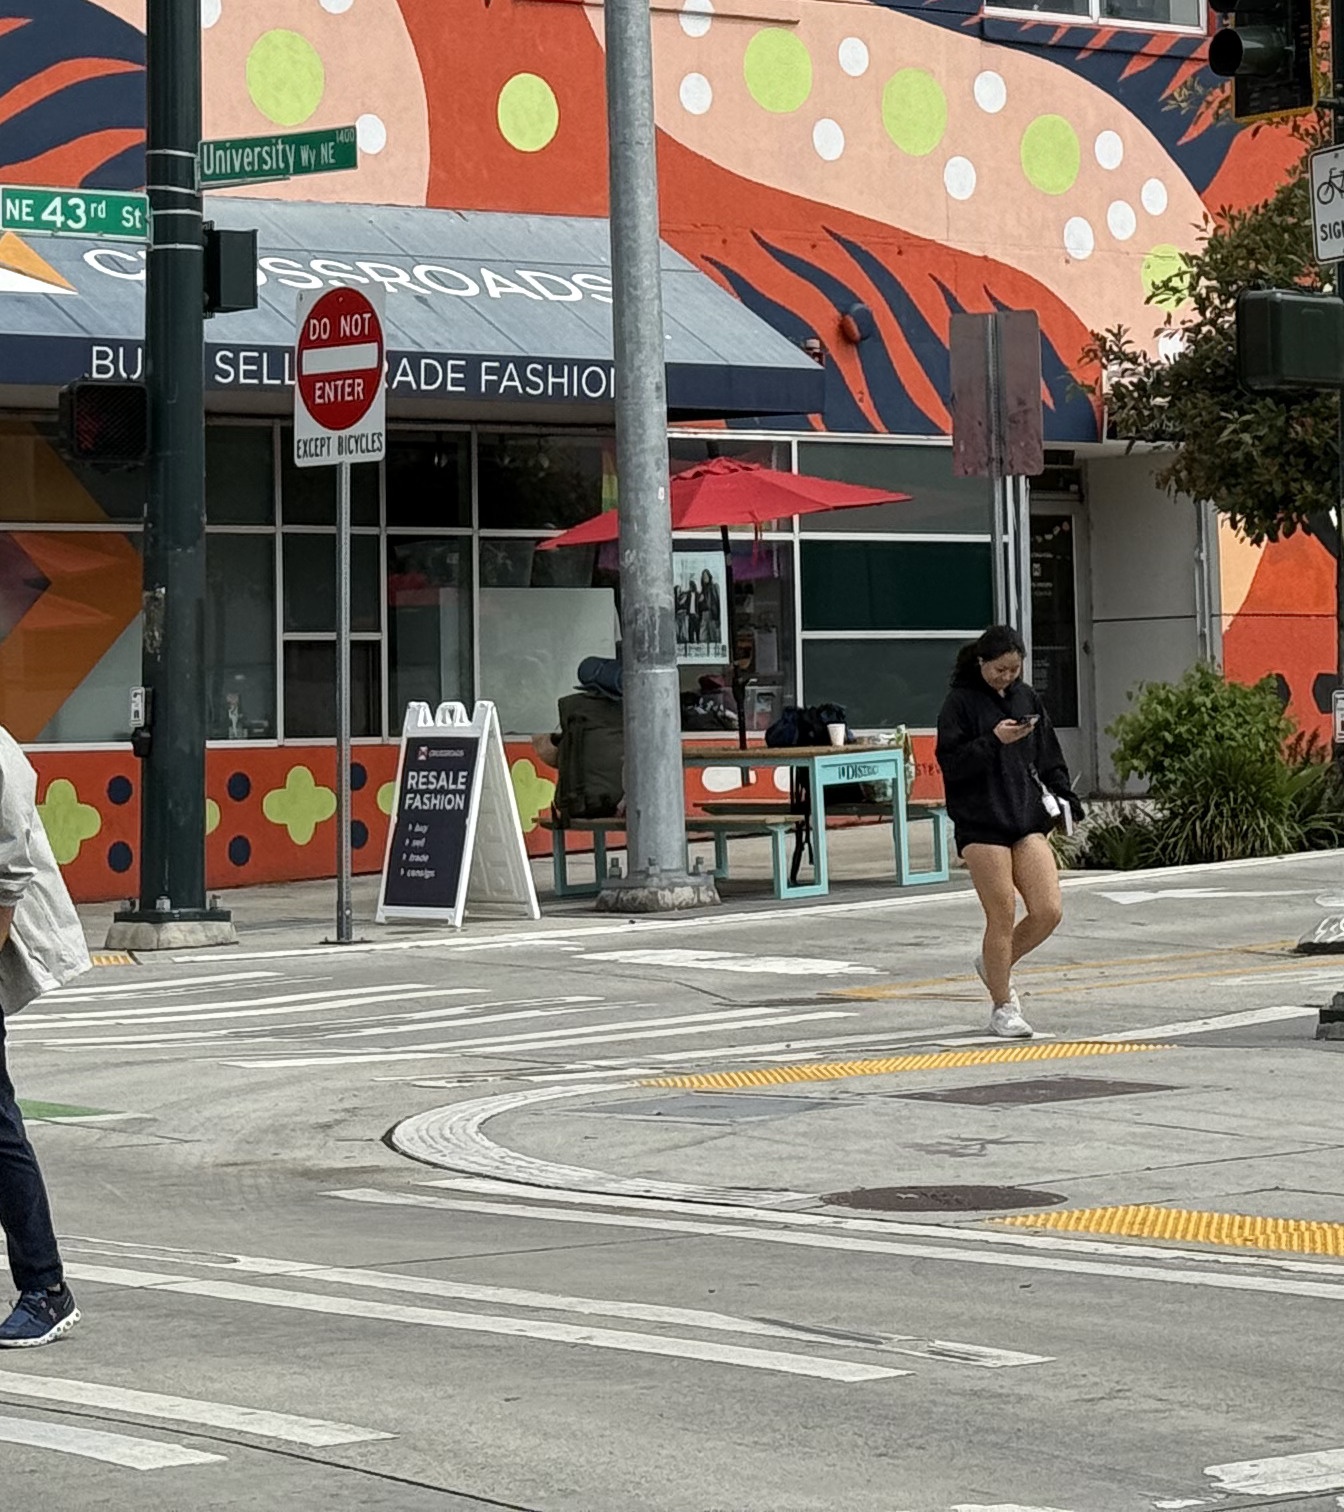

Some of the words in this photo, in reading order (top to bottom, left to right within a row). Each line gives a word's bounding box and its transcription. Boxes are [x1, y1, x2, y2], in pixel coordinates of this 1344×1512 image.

[335, 129, 355, 143] 1400
[203, 138, 296, 175] University
[300, 144, 316, 170] Wy
[320, 142, 336, 166] NE
[5, 198, 34, 222] NE
[40, 197, 106, 229] 43rd
[121, 206, 143, 229] St
[83, 248, 613, 303] CSSROADS
[309, 317, 331, 341] DO
[340, 313, 372, 338] NOT
[91, 345, 144, 380] BU
[214, 350, 296, 386] SELL
[384, 357, 466, 393] ADE
[481, 360, 614, 399] FASHIO
[314, 378, 364, 405] ENTER
[296, 436, 332, 460] EXCEPT
[337, 432, 383, 456] BICYCLES
[407, 770, 469, 790] RESALE
[404, 792, 466, 811] FASHION
